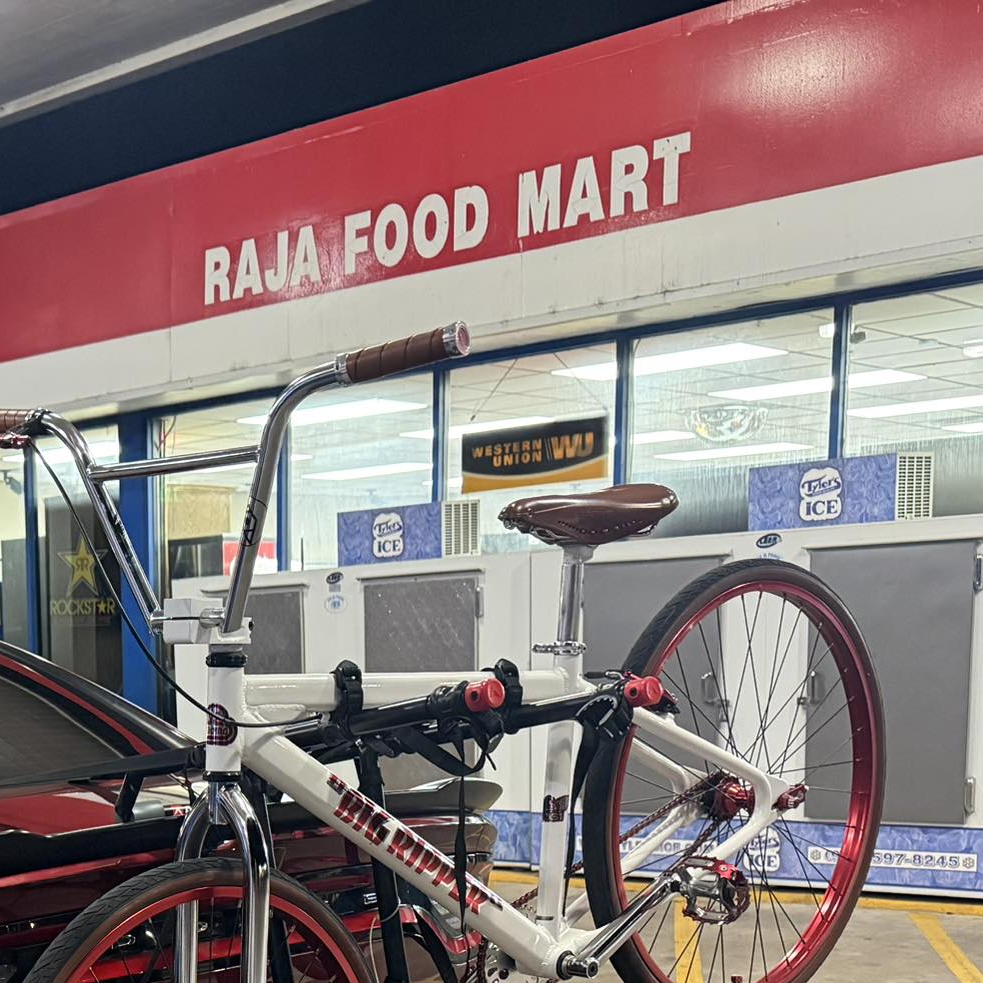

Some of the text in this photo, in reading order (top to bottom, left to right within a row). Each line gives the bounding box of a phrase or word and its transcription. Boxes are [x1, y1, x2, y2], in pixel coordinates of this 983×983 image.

[204, 131, 691, 305] RAJA FOOD MART
[472, 438, 542, 459] WESTERN
[492, 450, 542, 468] UNION
[805, 500, 838, 516] ICE
[377, 540, 401, 553] ICE
[334, 790, 390, 846] BIG
[872, 852, 960, 868] 597-8245
